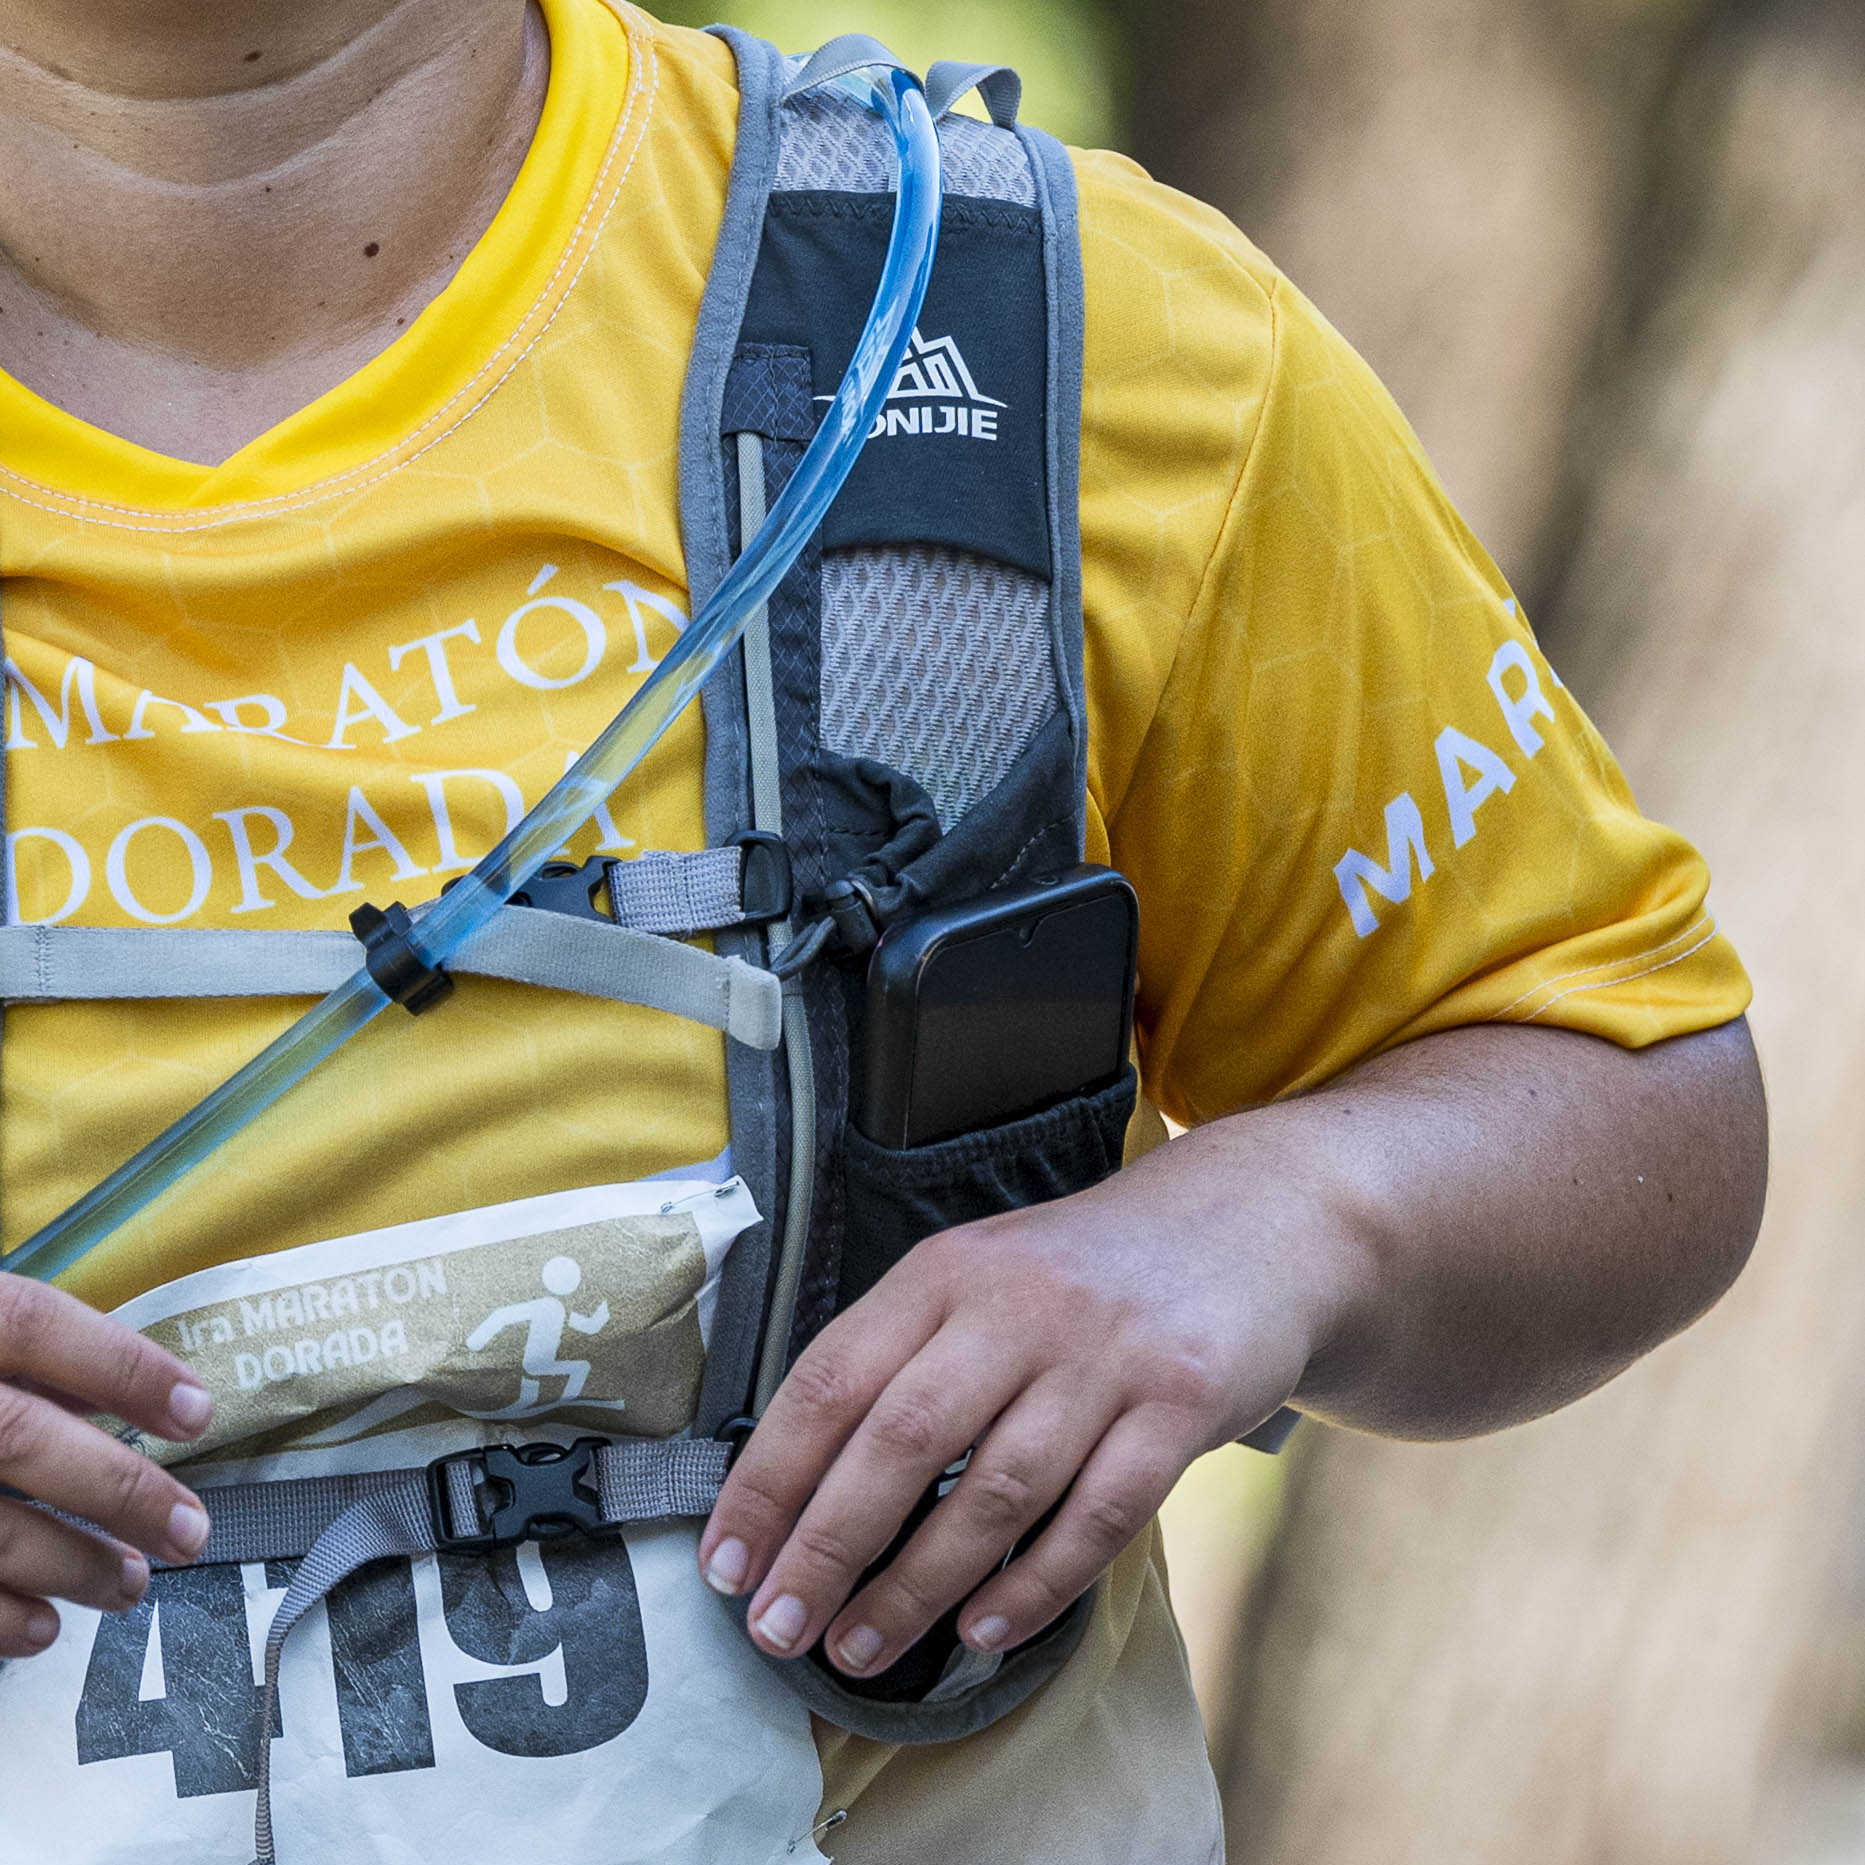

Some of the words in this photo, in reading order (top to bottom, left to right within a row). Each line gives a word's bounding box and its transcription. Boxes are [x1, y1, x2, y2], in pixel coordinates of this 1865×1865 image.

[5, 564, 689, 751] MARATÓN
[6, 750, 636, 926] DORADA
[1334, 598, 1564, 938] MAR
[235, 1318, 409, 1392] DORADA
[238, 1257, 448, 1336] MARATON
[75, 1534, 649, 1798] 419
